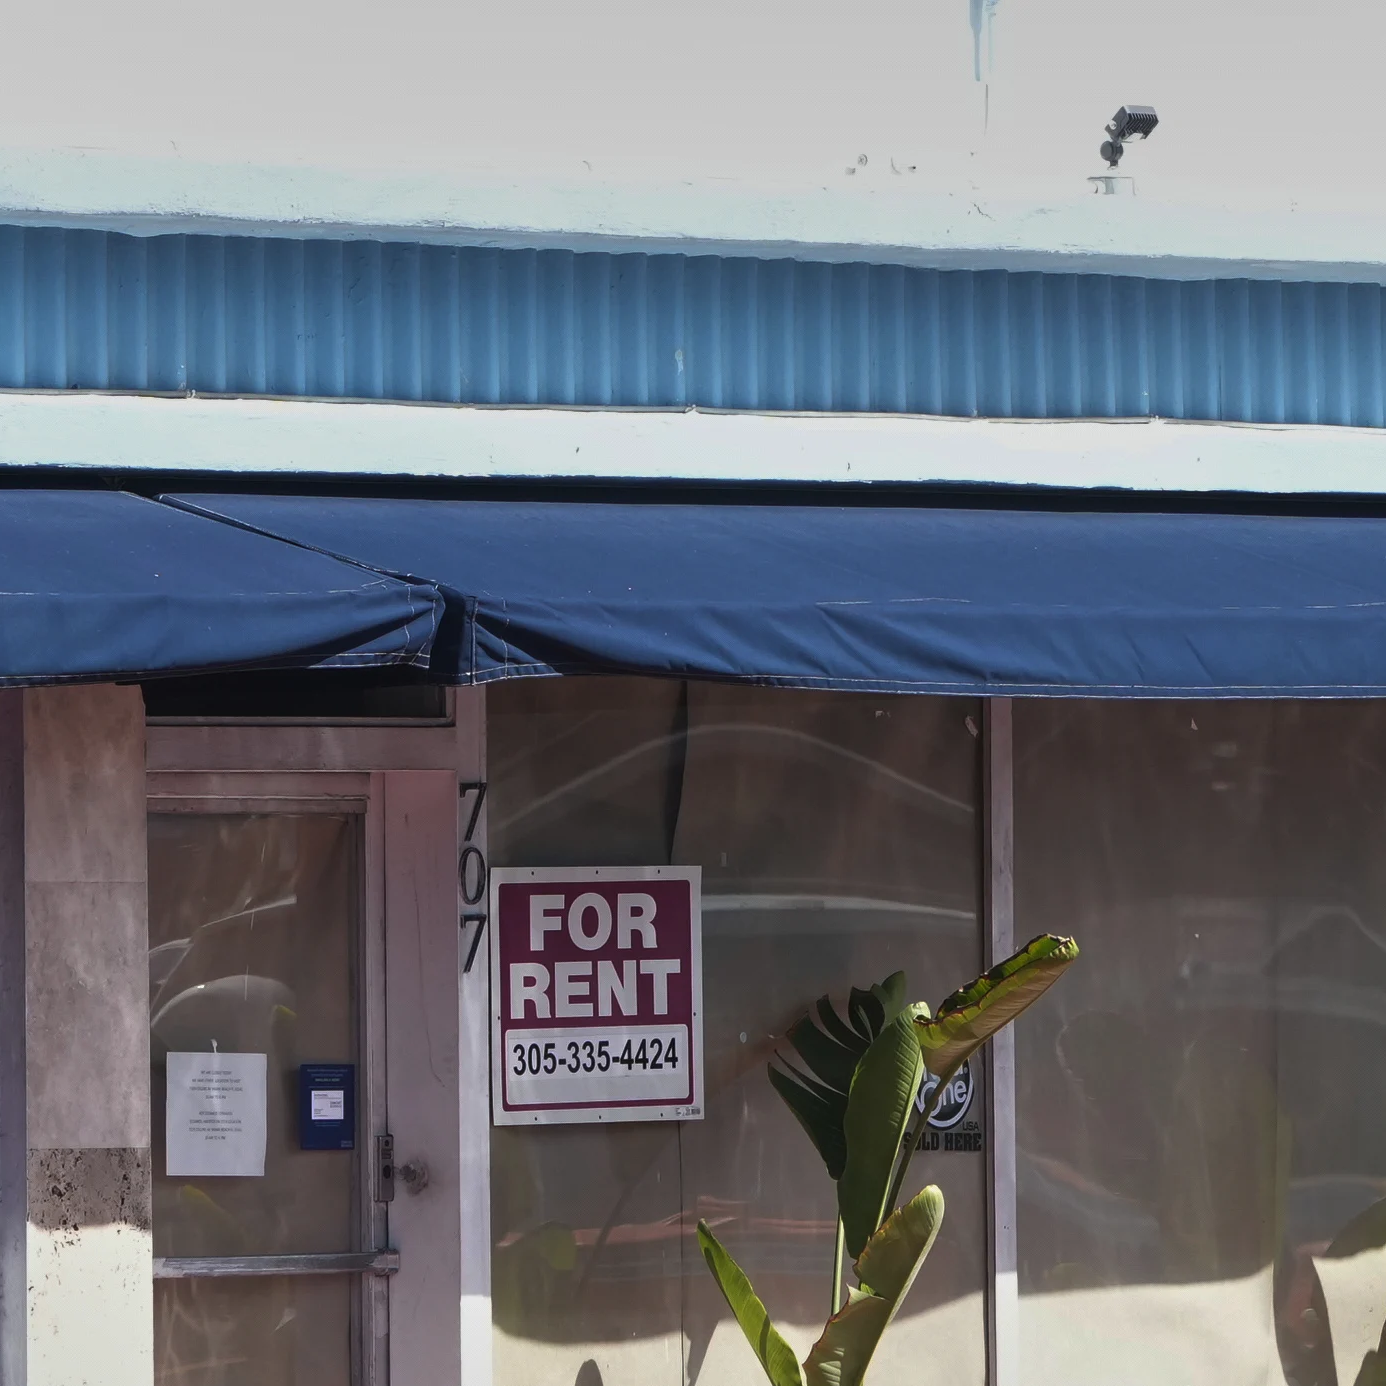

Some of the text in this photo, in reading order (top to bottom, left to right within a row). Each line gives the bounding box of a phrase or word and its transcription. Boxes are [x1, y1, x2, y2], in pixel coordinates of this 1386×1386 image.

[459, 782, 487, 973] 707
[529, 892, 658, 951] FOR
[509, 958, 681, 1020] RENT
[512, 1037, 679, 1076] 305-335-4424
[944, 1132, 982, 1152] HERE
[962, 1121, 979, 1131] USA
